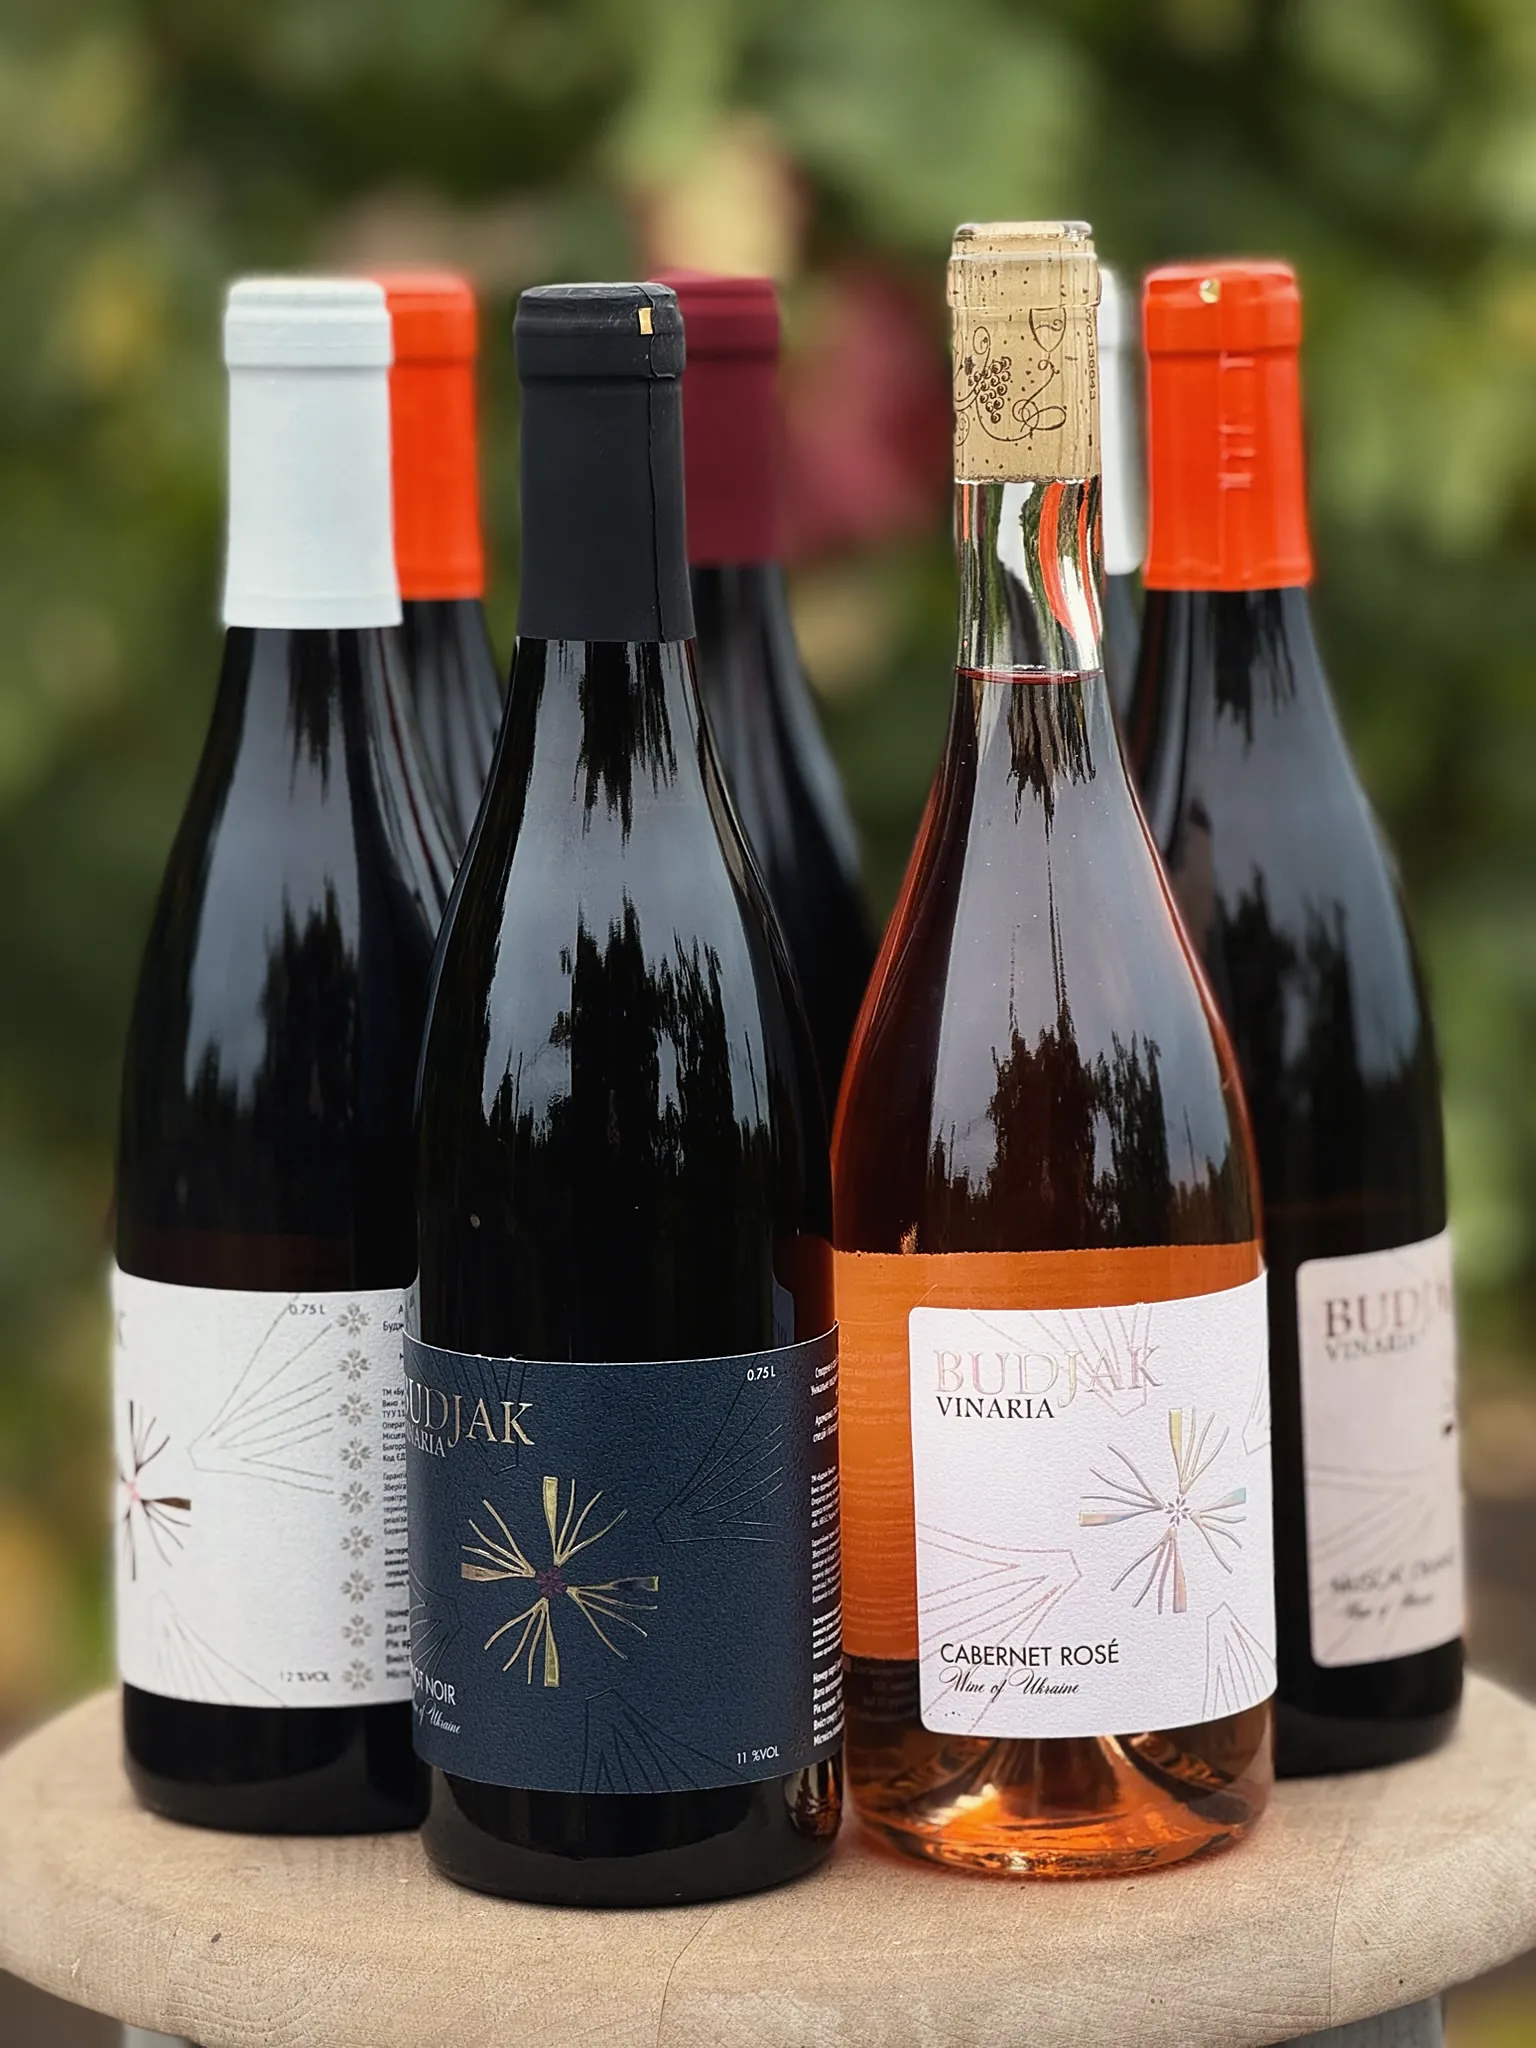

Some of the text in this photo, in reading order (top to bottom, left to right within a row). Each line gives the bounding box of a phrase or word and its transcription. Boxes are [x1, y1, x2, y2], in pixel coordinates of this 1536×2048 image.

[747, 1365, 776, 1381] 0.75 L
[933, 1345, 1164, 1408] BUDJAK
[936, 1395, 1055, 1419] VINARIA
[940, 1637, 1120, 1667] CABERNET ROSÉ
[425, 1674, 456, 1706] NOIR
[938, 1661, 1080, 1703] Wine of Ukraine
[424, 1697, 462, 1735] Ukraine
[736, 1745, 780, 1765] 11 %VOL
